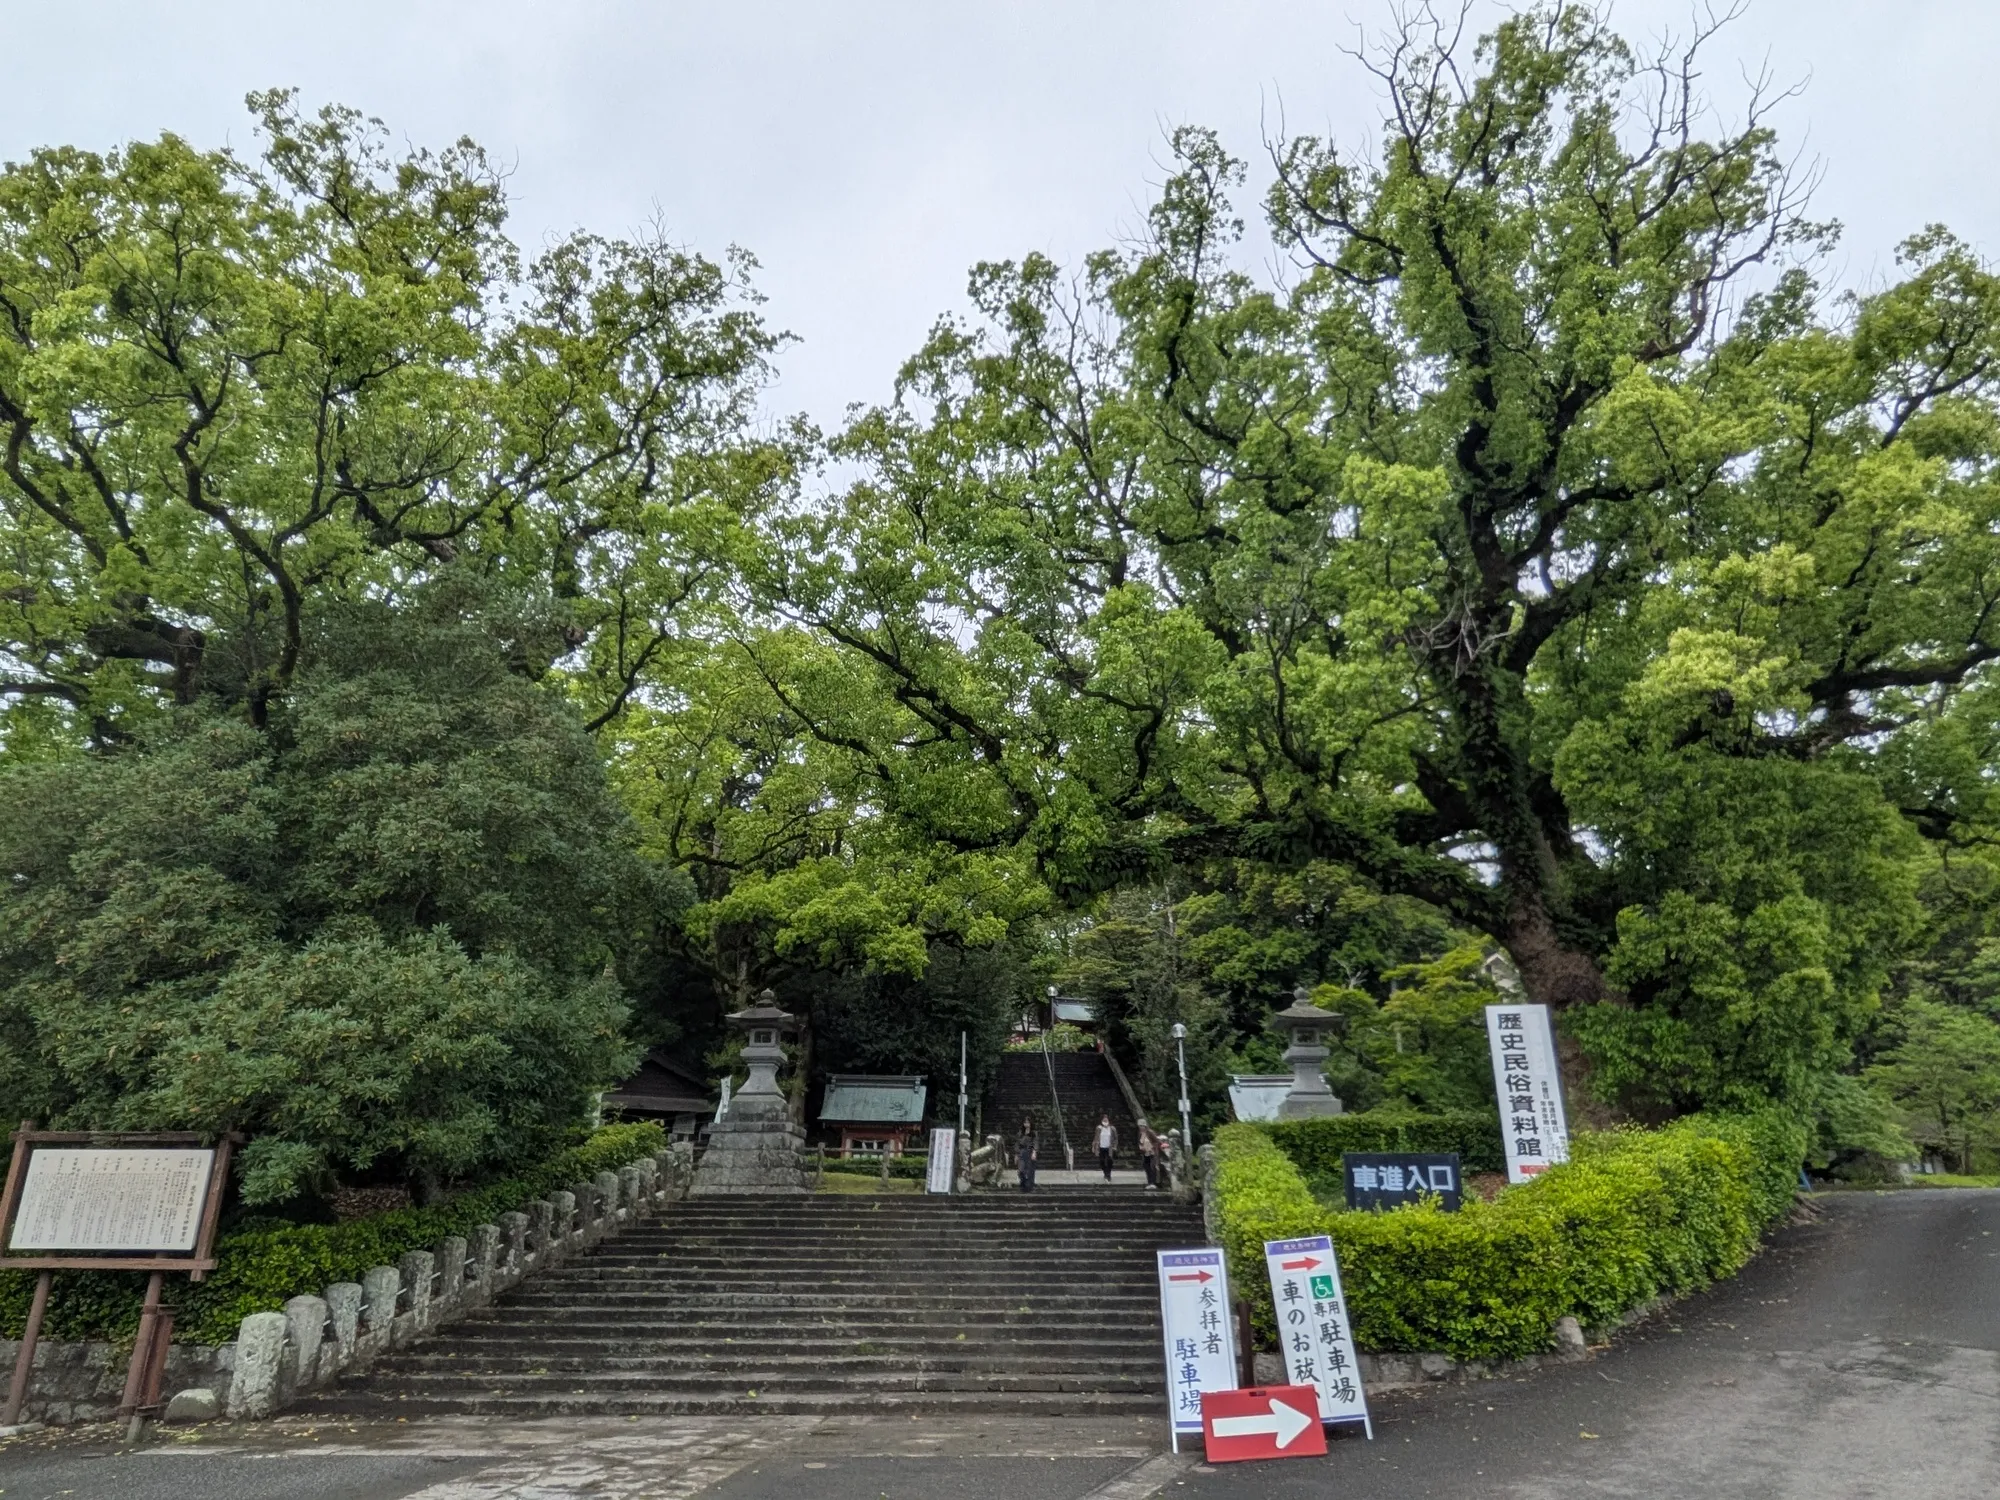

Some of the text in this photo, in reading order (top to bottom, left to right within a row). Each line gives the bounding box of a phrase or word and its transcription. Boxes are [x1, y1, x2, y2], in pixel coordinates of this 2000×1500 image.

[1497, 1013, 1542, 1157] 歴史民俗資料館
[1352, 1165, 1454, 1191] 車進入口
[1198, 1287, 1222, 1355] 参拝者
[1313, 1300, 1341, 1318] 専用
[1175, 1338, 1202, 1416] 駐車場
[1319, 1318, 1356, 1404] 駐車場
